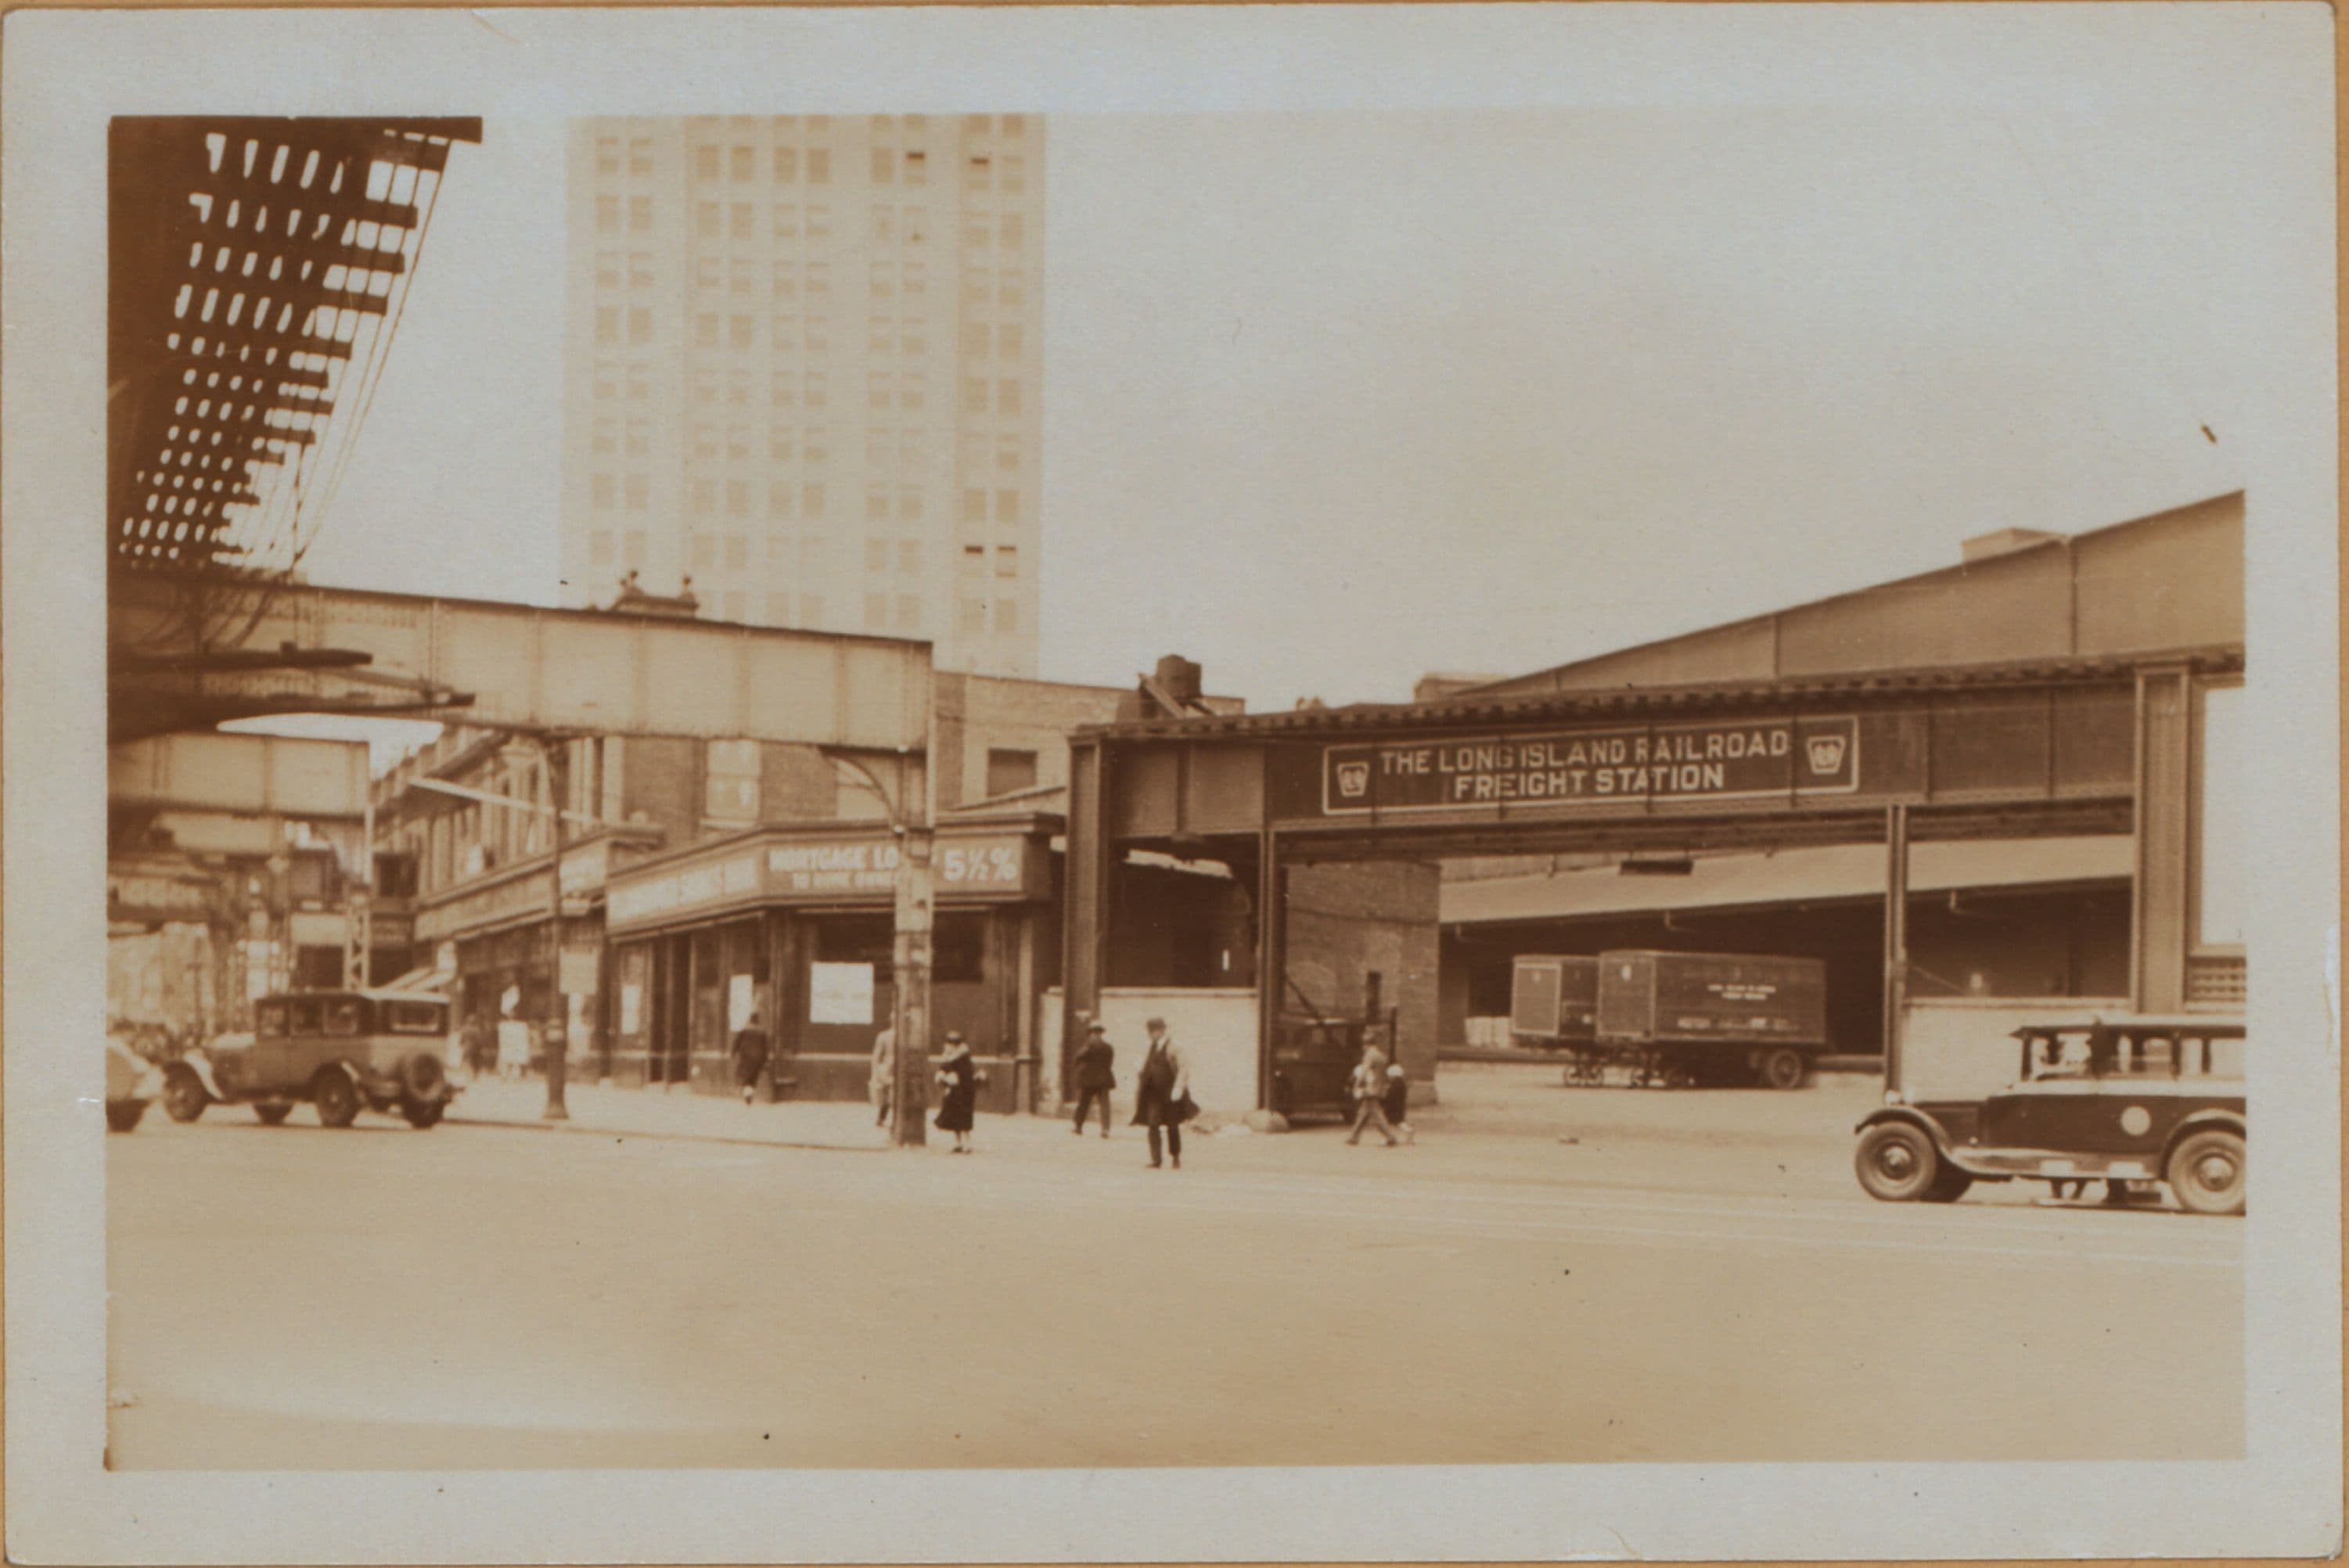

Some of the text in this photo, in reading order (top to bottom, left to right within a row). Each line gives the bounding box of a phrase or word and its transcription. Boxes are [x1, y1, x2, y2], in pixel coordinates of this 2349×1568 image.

[1381, 749, 1431, 775] THE
[1439, 744, 1515, 773] LONG
[1521, 739, 1626, 768] ISLAND
[1635, 729, 1789, 763] RAILROAD
[1455, 762, 1725, 800] FREIGHT STATION
